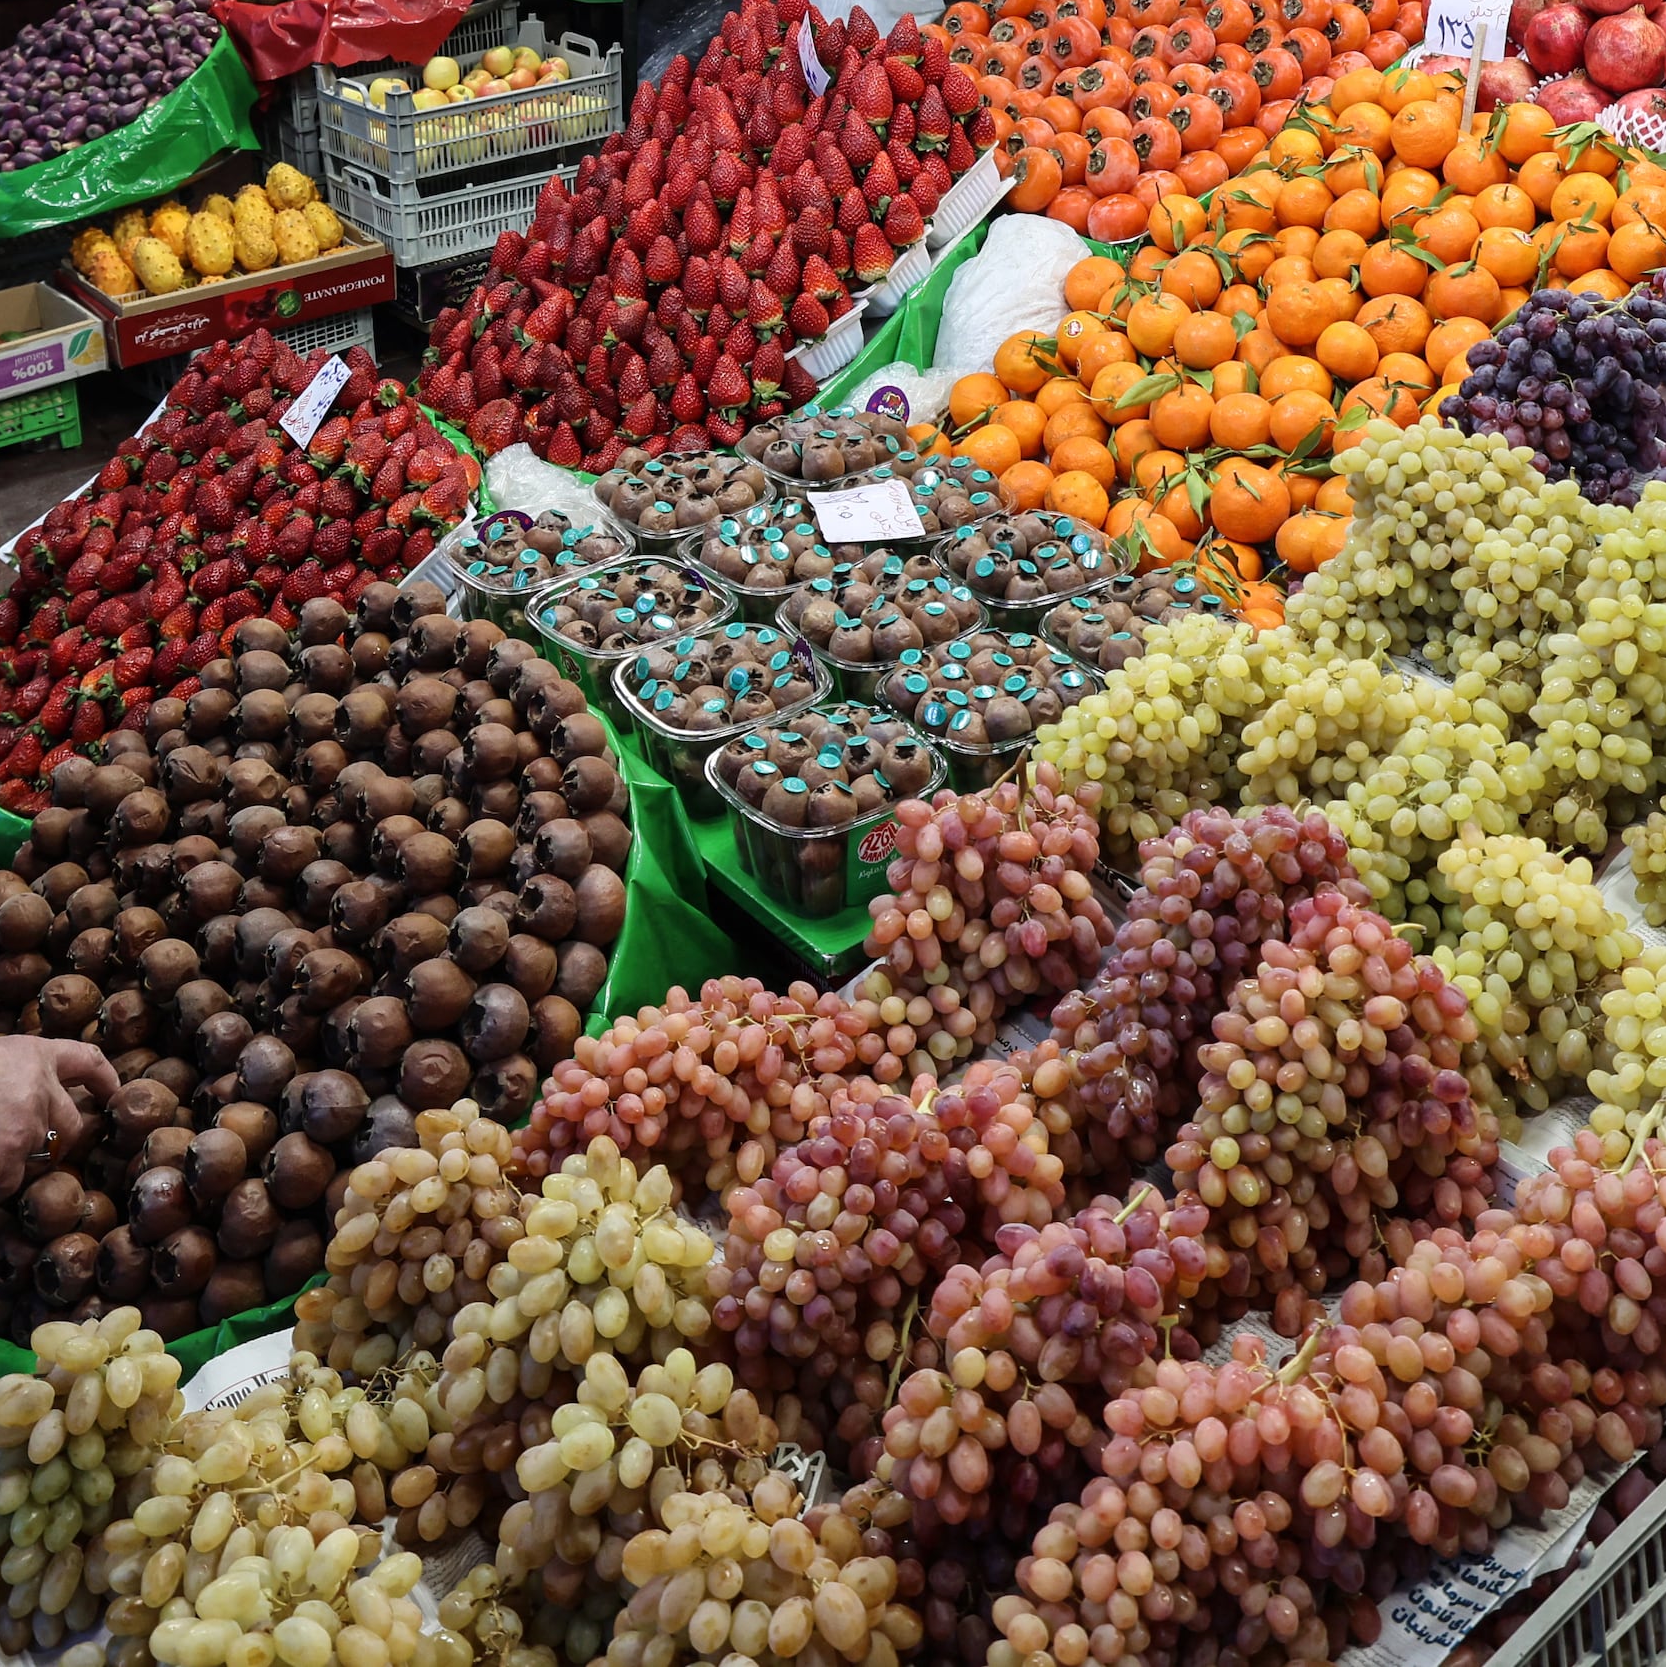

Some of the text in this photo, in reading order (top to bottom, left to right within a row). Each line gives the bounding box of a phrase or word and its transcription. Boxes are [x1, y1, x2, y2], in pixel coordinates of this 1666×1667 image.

[304, 274, 385, 302] POMEGRANATE
[205, 1385, 252, 1413] Some
[1408, 1587, 1453, 1624] قانون
[1391, 1605, 1429, 1641] بنیان
